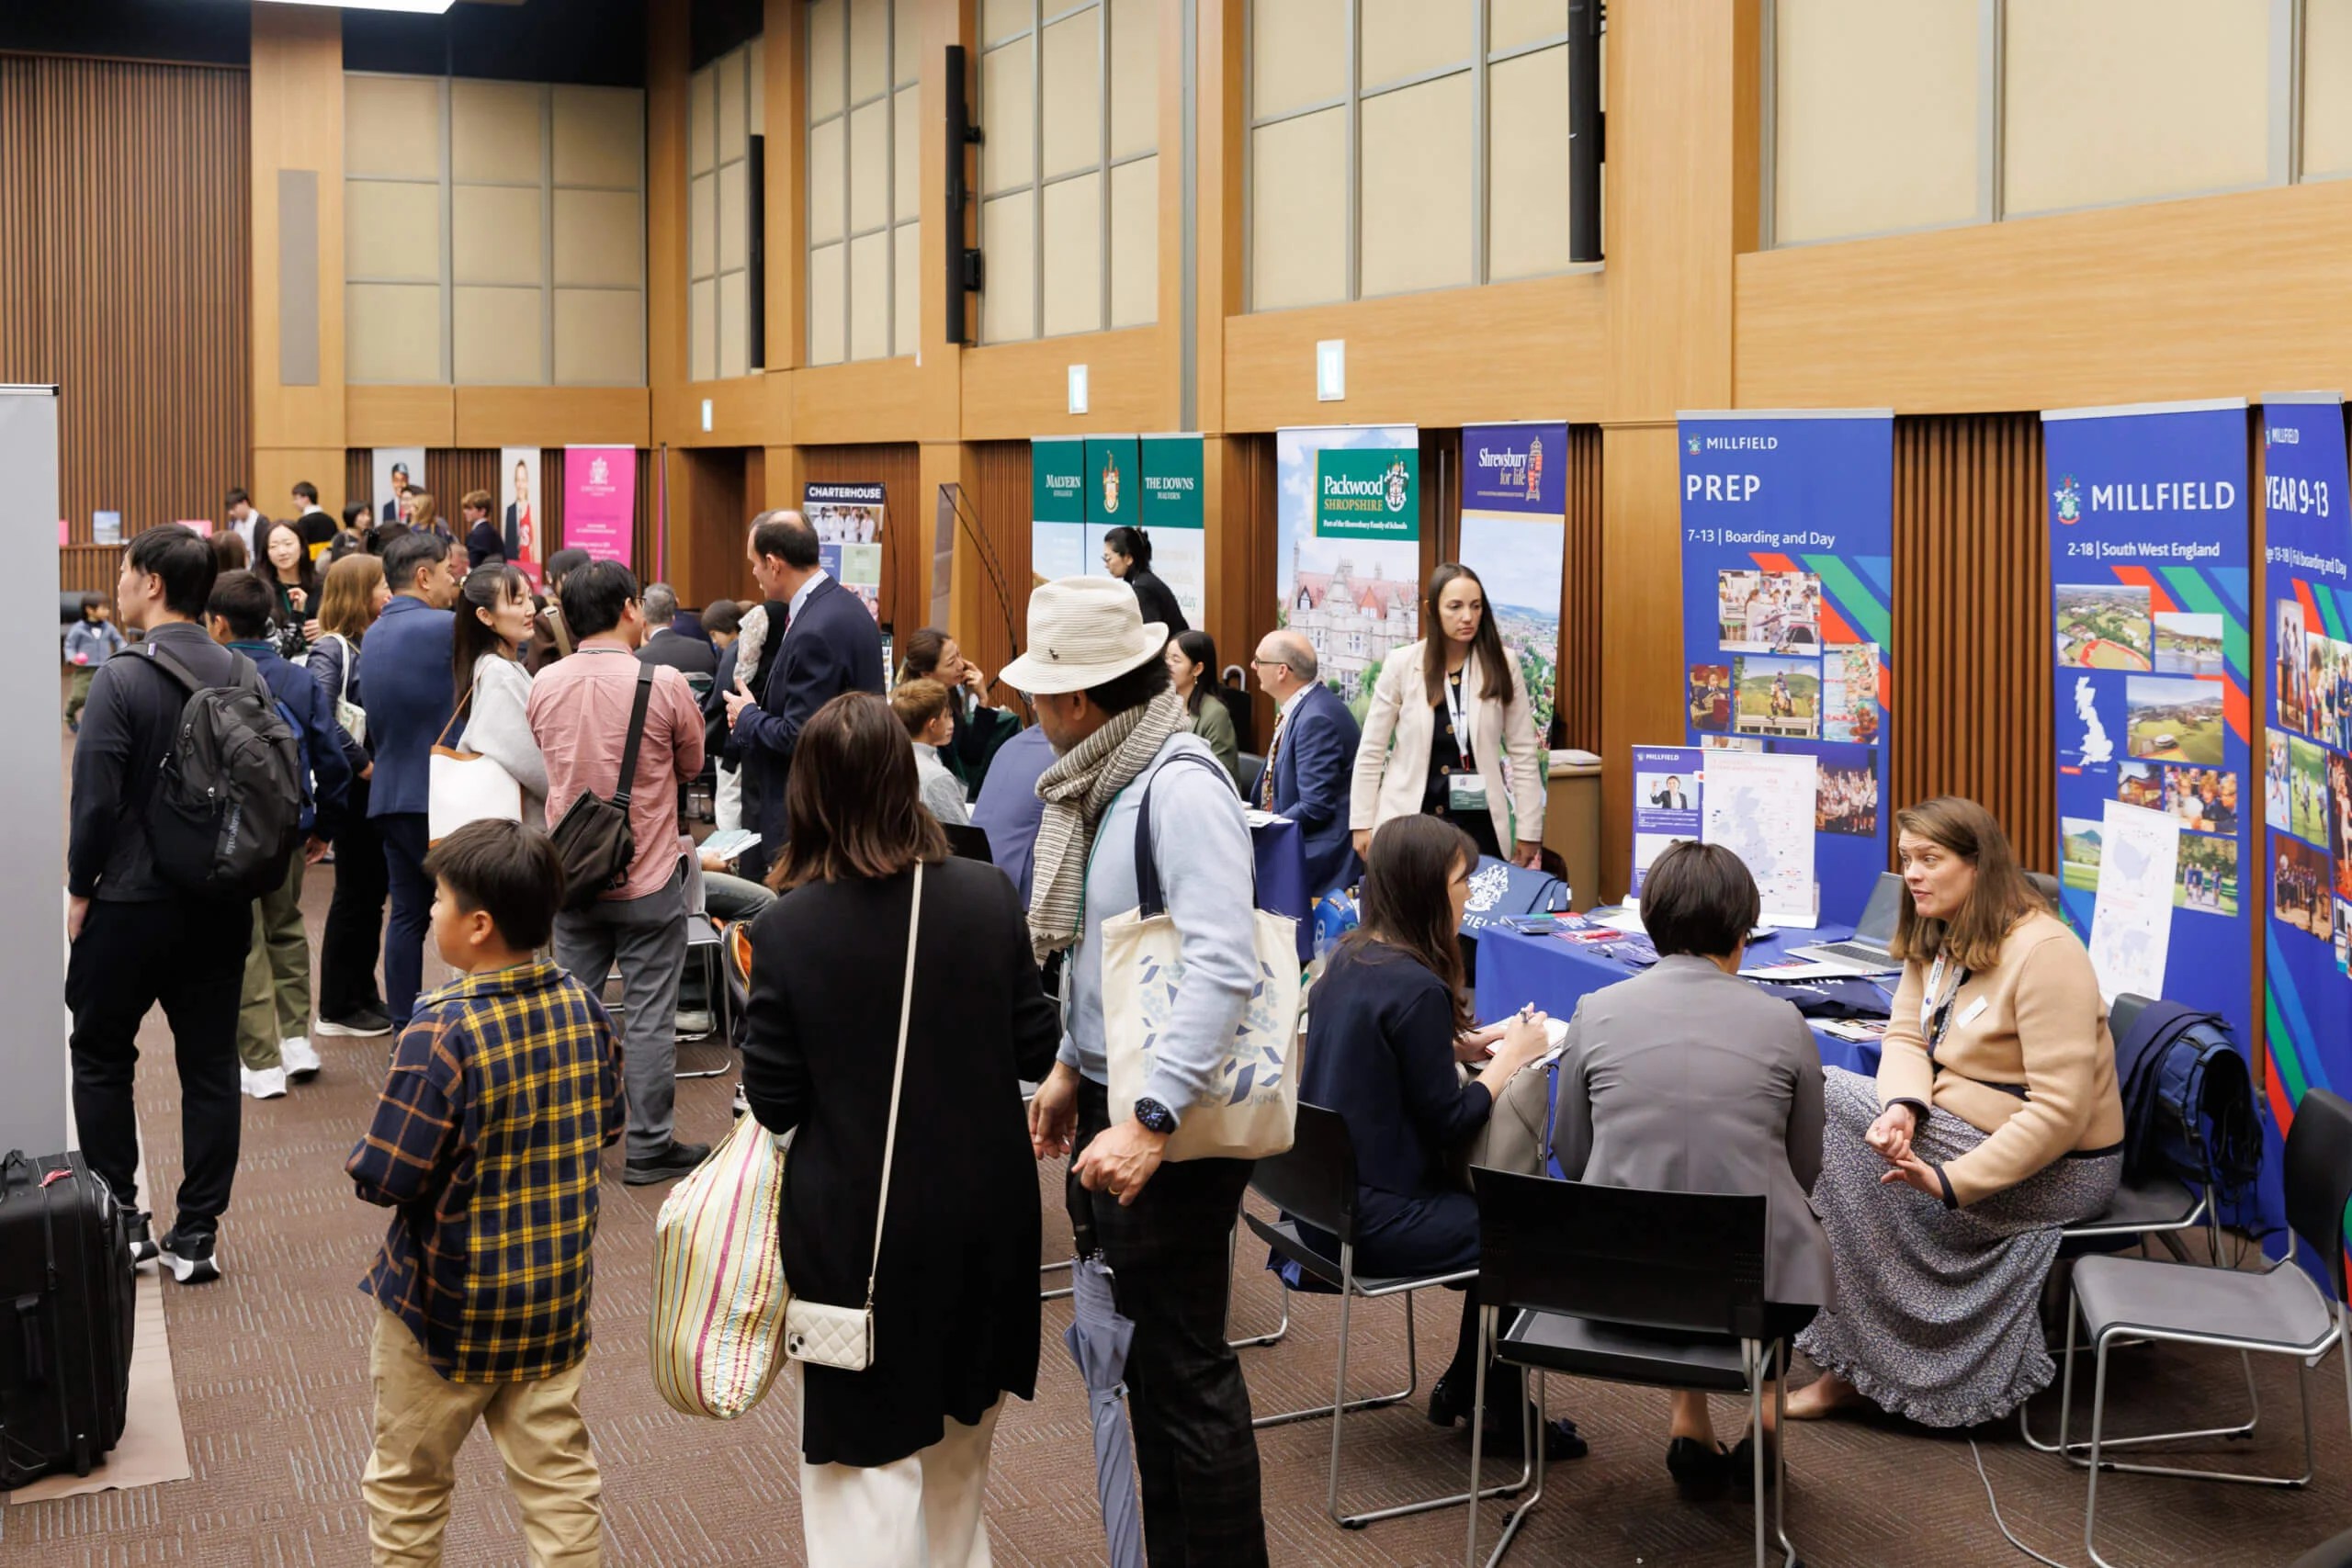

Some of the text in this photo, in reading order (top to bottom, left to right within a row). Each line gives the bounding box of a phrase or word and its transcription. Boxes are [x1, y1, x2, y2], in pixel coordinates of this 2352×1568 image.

[1706, 436, 1779, 450] MILLFIELD
[2271, 427, 2300, 444] MILLFIELD
[1478, 447, 1528, 468] Shrewsbury
[1046, 474, 1081, 488] MALVERN
[1145, 477, 1193, 491] THE DOWNS
[1324, 474, 1384, 495] Packwood
[1499, 468, 1526, 485] for life
[808, 486, 882, 499] CHARTERHOUSE
[1686, 474, 1760, 502] PREP
[2091, 481, 2235, 512] MILLFIELD
[2265, 475, 2329, 517] YEAR 9-13
[1324, 499, 1383, 512] SHROPSHIRE
[1687, 528, 1714, 542] 7-13
[1724, 530, 1780, 547] Boarding
[1782, 531, 1806, 545] and
[1809, 532, 1836, 549] Day
[2067, 542, 2094, 557] 2-18
[2101, 542, 2137, 557] South
[2137, 542, 2169, 557] West
[2171, 541, 2221, 560] England
[2301, 551, 2325, 575] boarding
[2325, 557, 2335, 573] and
[2335, 558, 2347, 581] Day
